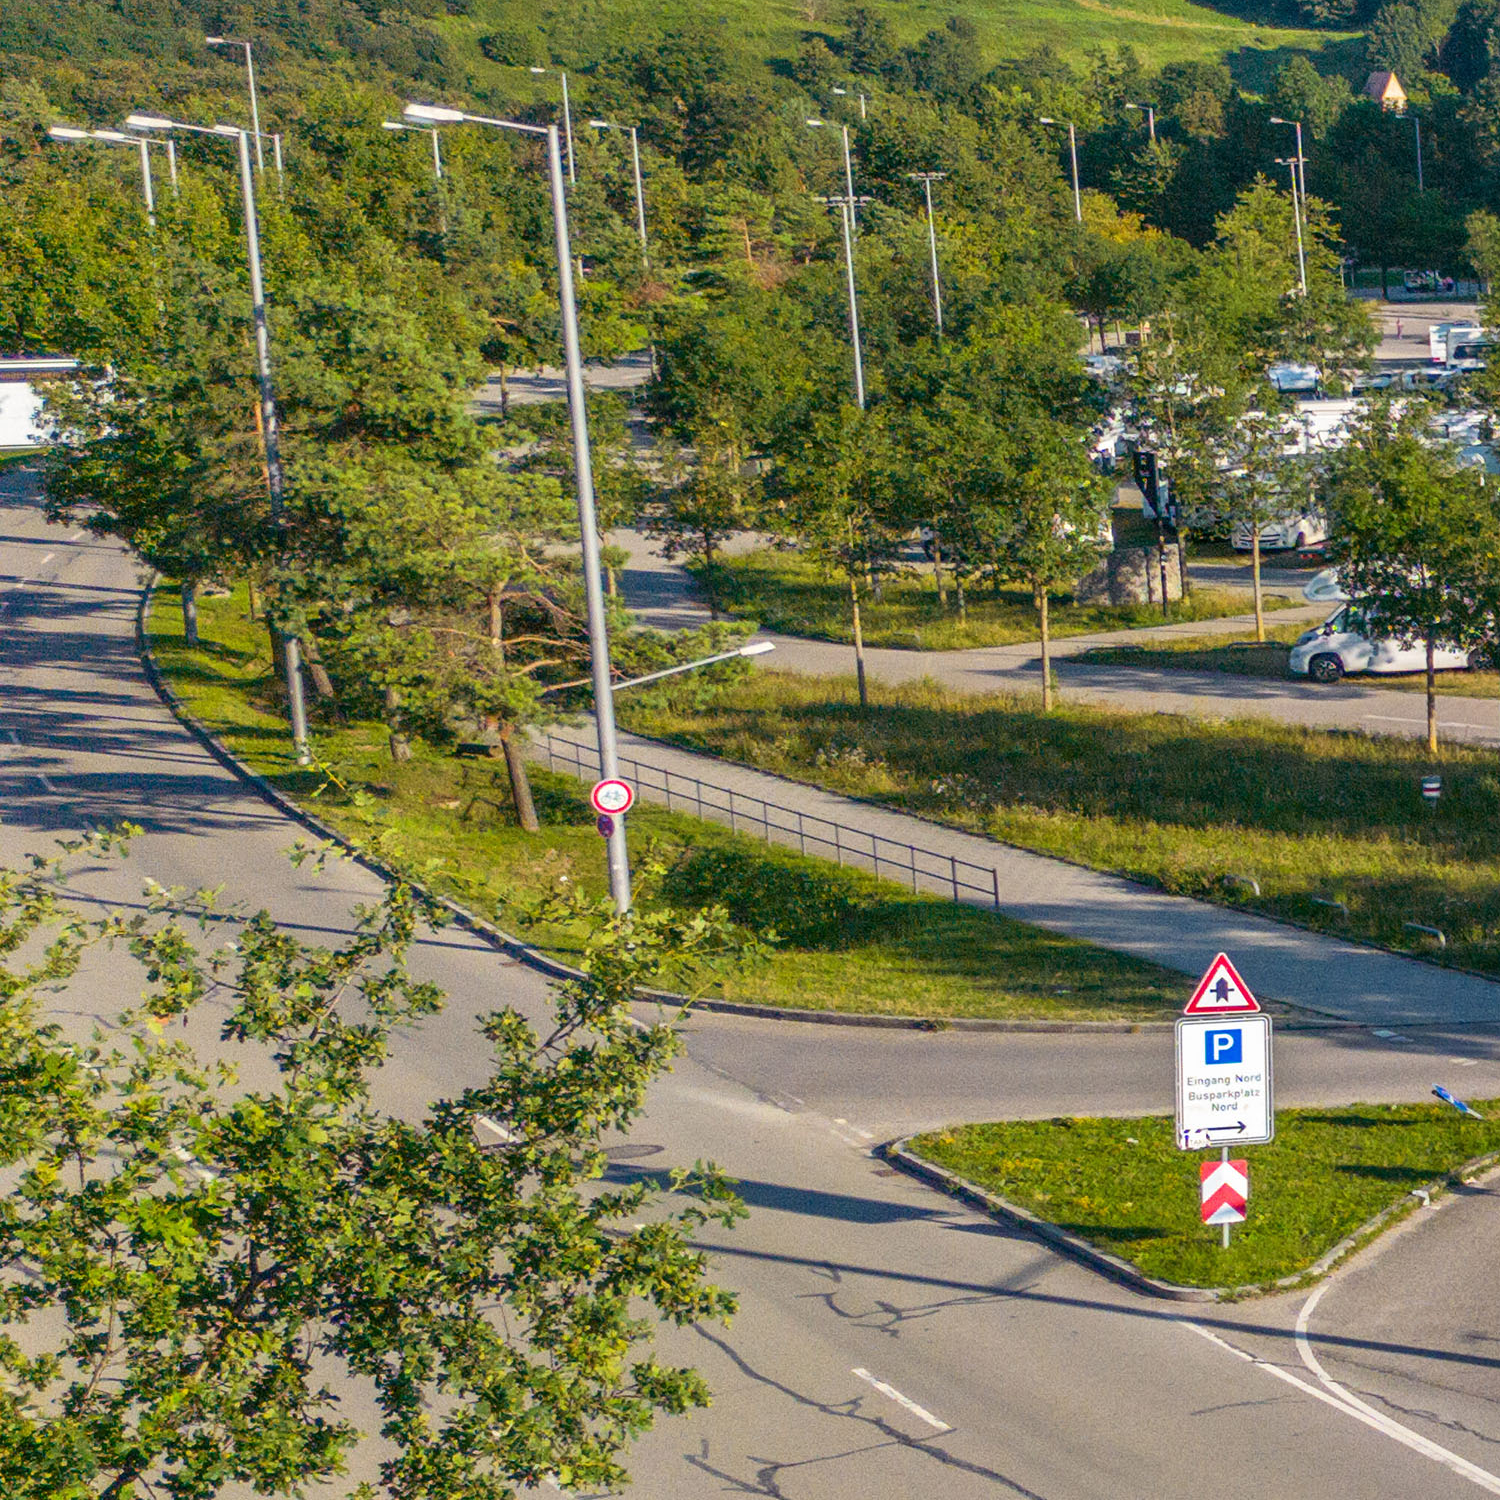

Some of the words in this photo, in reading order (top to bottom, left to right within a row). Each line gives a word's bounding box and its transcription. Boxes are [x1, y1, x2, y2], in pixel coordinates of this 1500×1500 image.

[1214, 1034, 1233, 1060] P
[1187, 1077, 1231, 1087] Eingang
[1235, 1074, 1261, 1082] Nord
[1212, 1103, 1238, 1111] Nord
